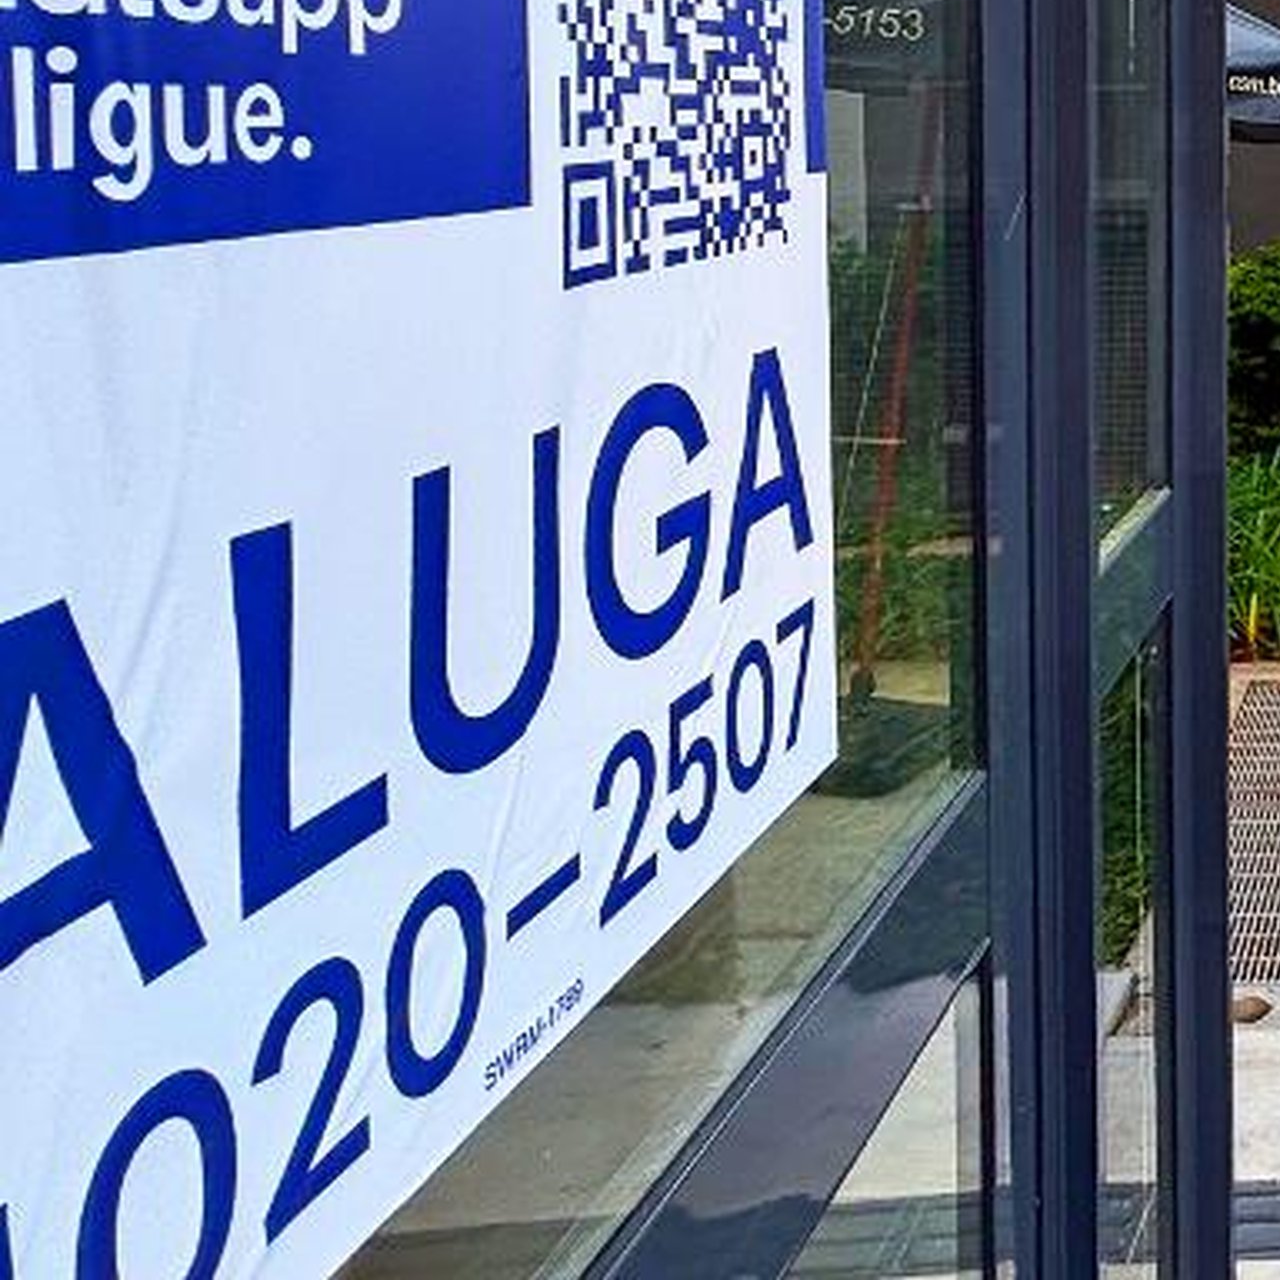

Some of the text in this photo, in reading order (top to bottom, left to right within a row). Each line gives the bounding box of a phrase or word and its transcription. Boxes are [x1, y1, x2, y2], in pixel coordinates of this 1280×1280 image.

[12, 46, 312, 201] ligue.
[0, 347, 814, 986] ALUGA
[0, 597, 815, 1280] 020-2507
